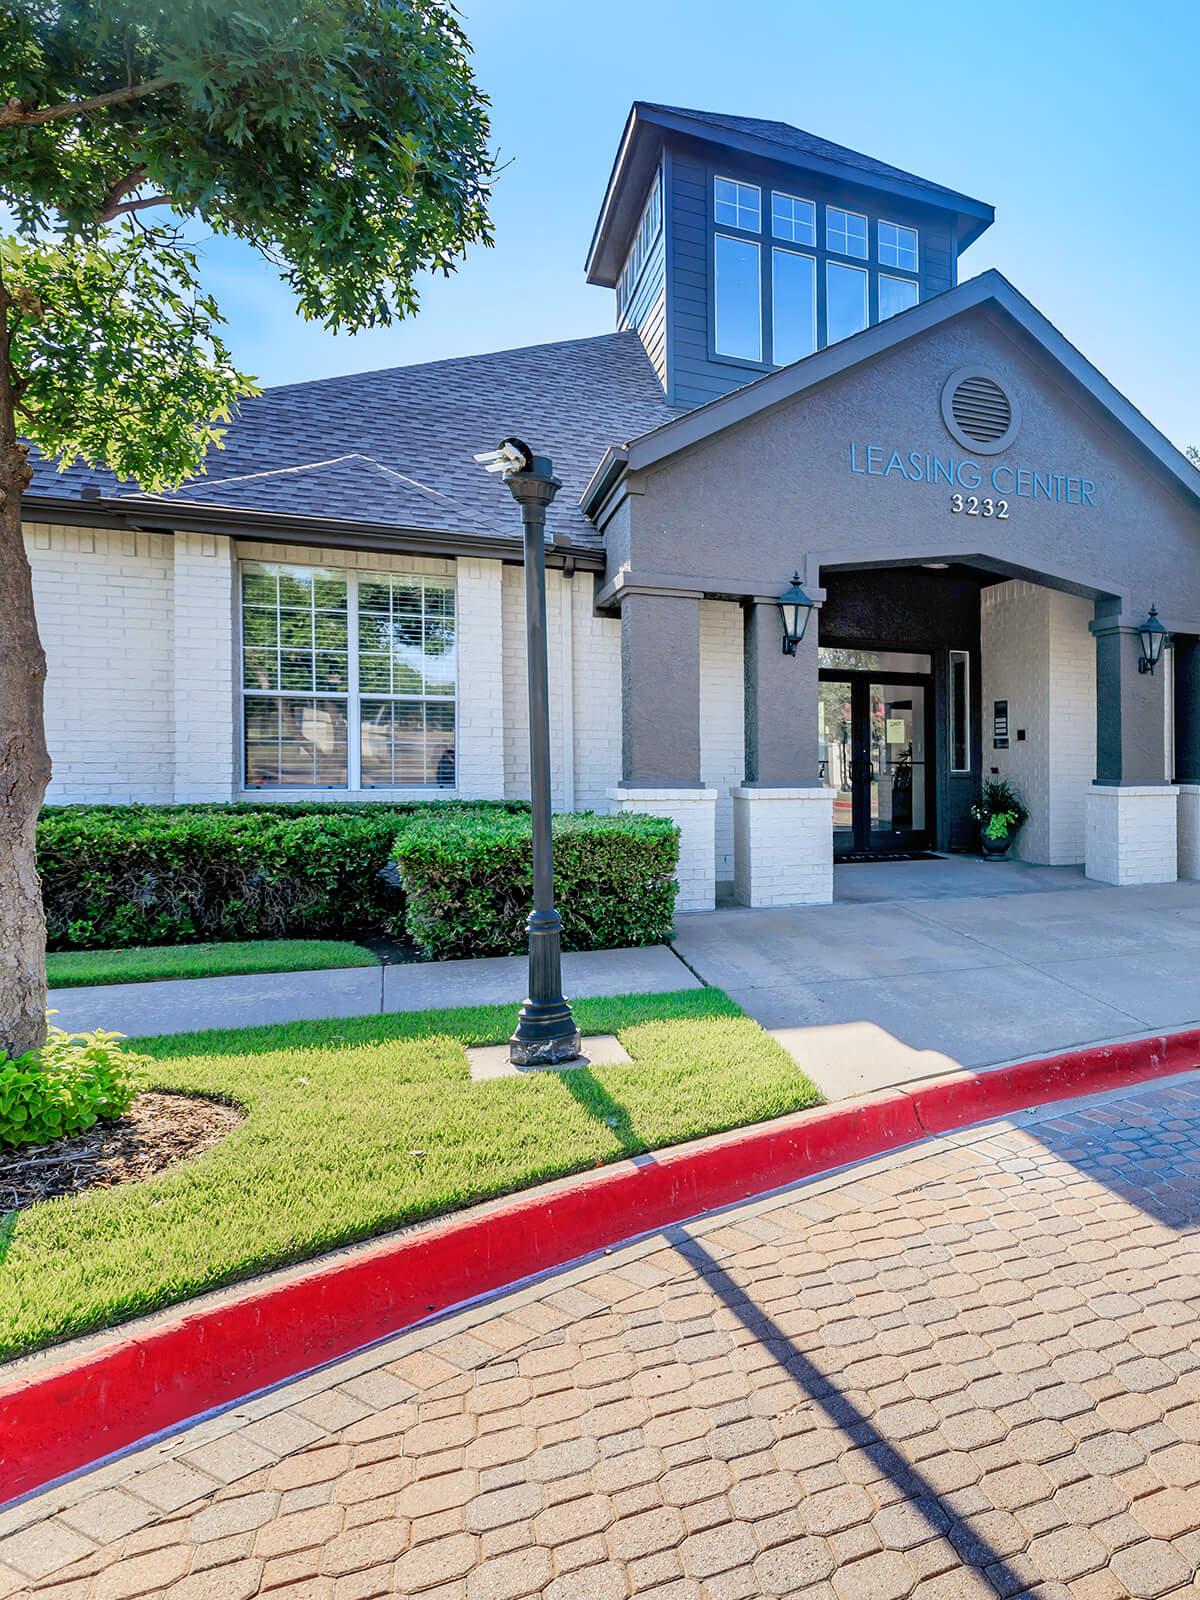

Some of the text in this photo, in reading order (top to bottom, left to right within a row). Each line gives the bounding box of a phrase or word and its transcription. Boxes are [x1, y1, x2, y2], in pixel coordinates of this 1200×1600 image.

[850, 441, 1097, 507] LEASING CENTER
[951, 493, 1010, 519] 3232
